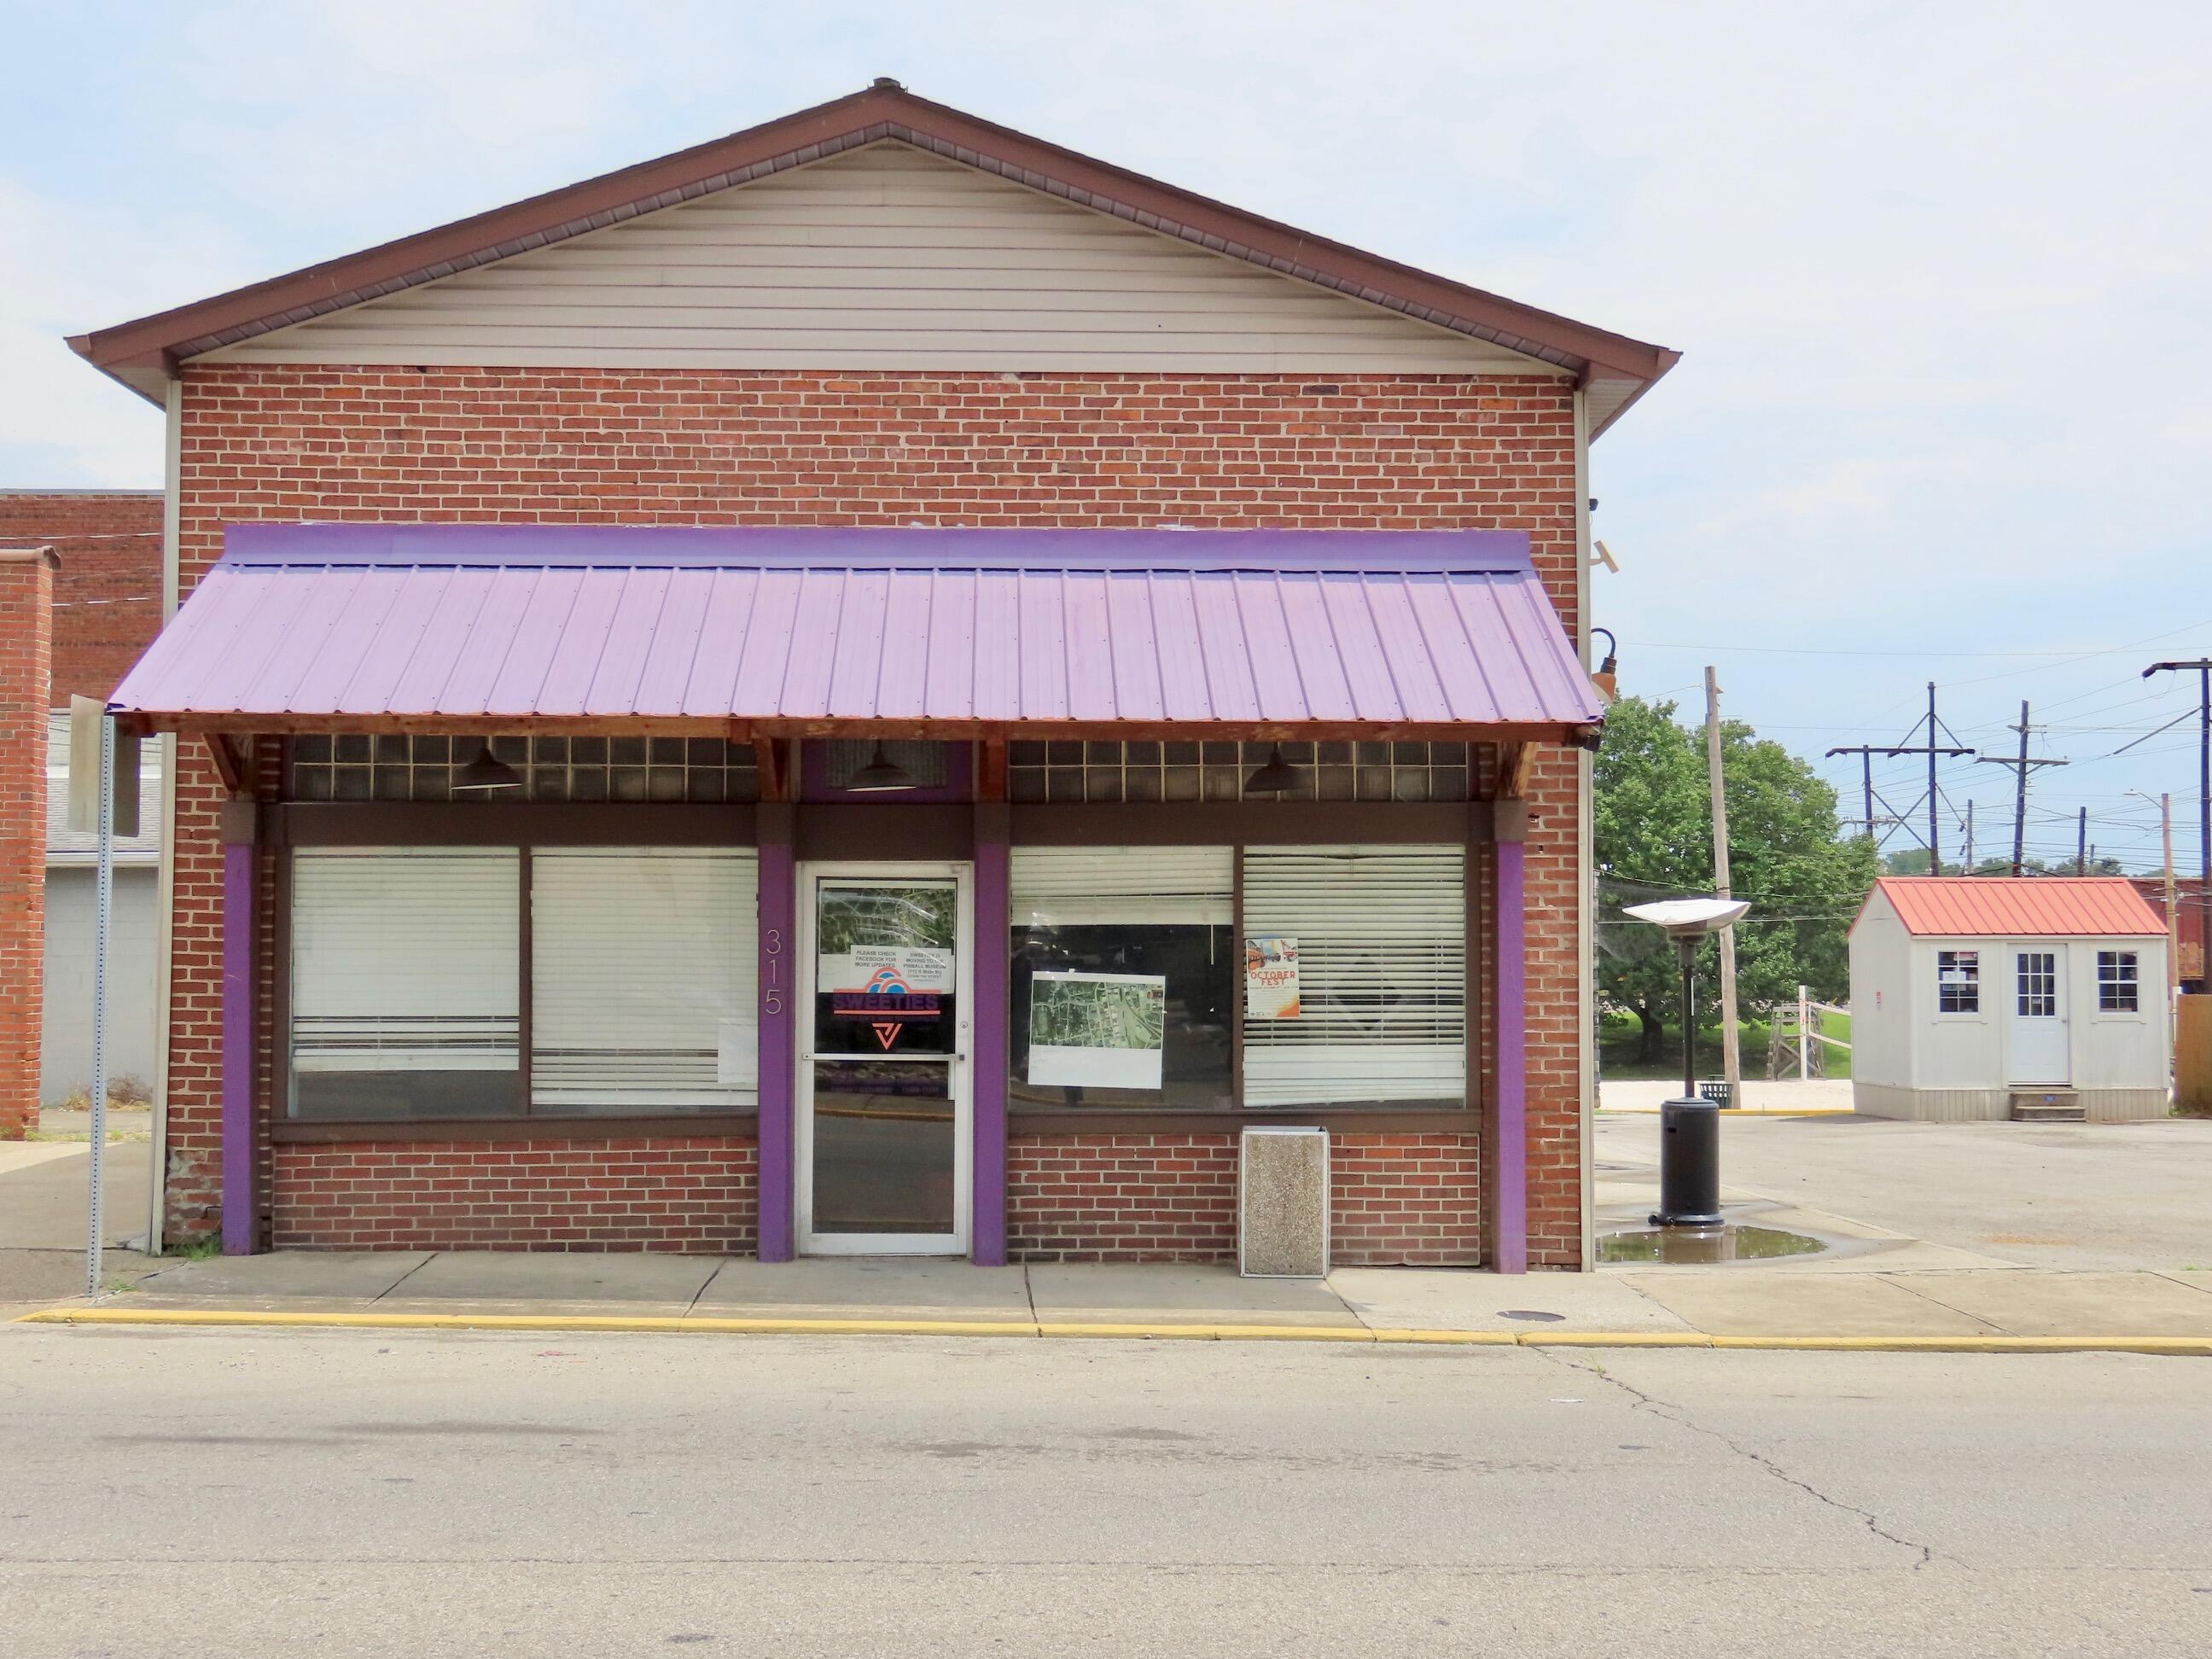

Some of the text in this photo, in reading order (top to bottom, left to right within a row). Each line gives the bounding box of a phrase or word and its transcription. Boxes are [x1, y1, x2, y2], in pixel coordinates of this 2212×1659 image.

[765, 929, 782, 1015] 315
[1250, 970, 1295, 980] OCTOBER
[832, 993, 938, 1010] SWEETIES
